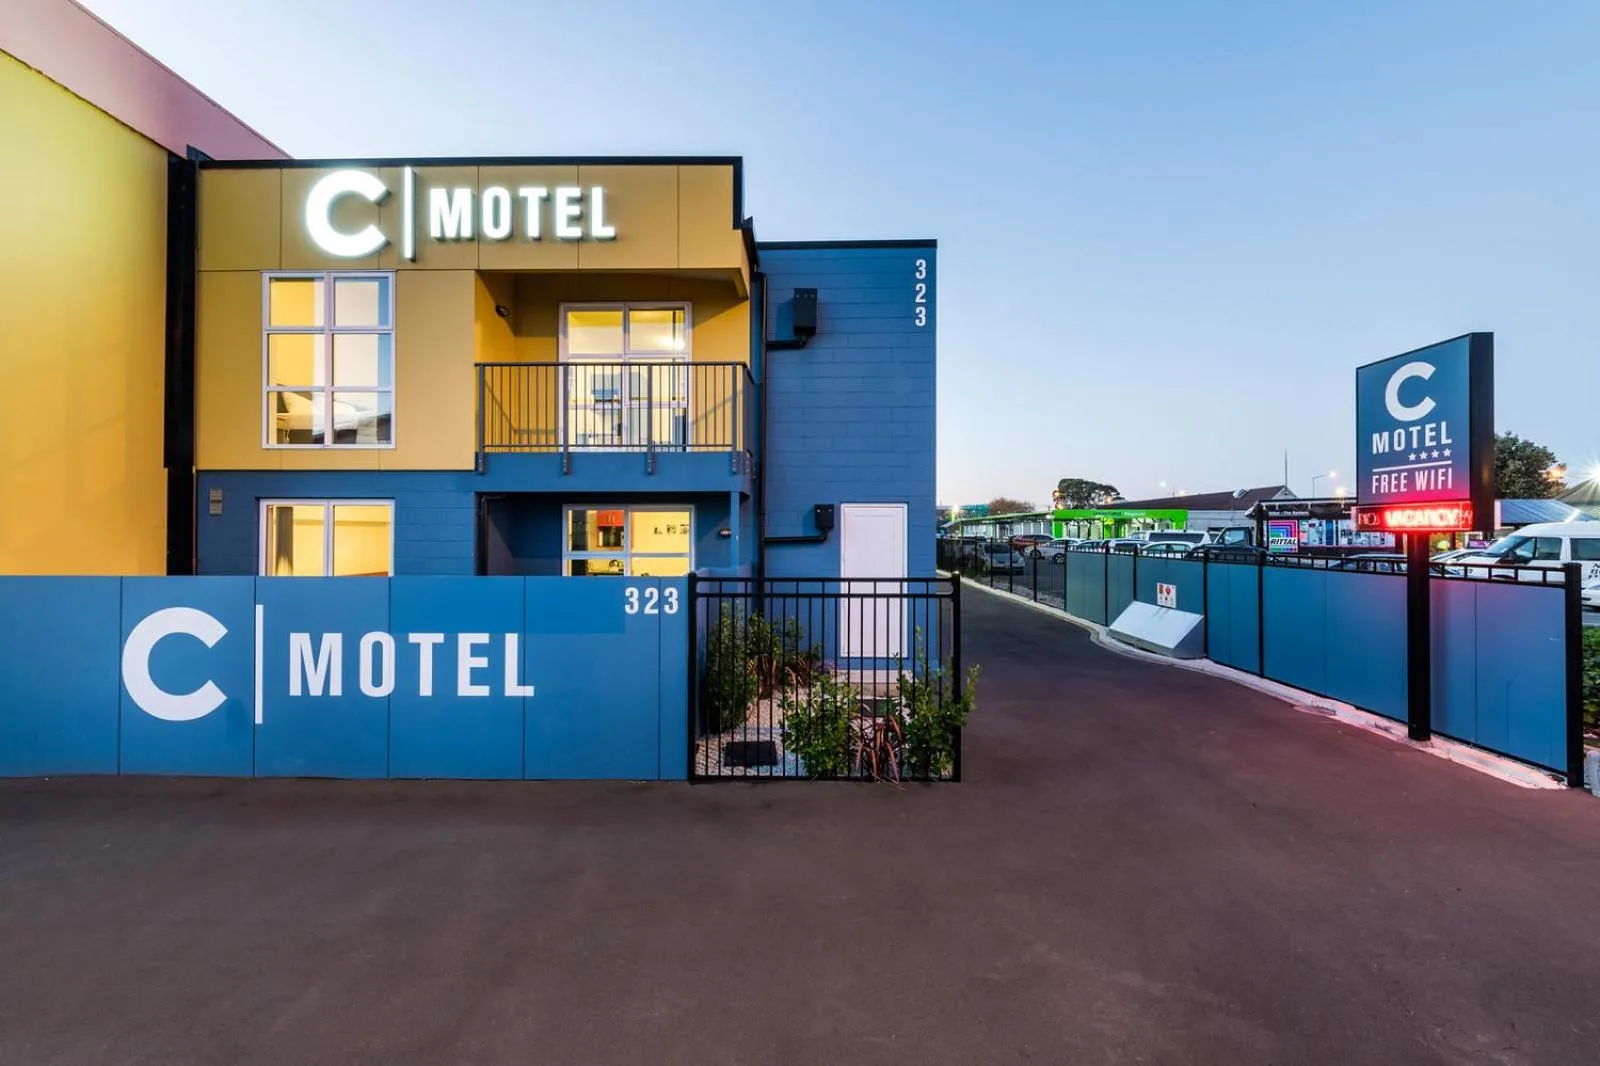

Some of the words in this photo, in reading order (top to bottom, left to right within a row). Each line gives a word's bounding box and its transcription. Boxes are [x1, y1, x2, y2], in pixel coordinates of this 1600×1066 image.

[306, 169, 388, 257] C
[429, 186, 616, 240] MOTEL
[915, 259, 927, 327] 323
[1385, 361, 1437, 421] C
[1372, 421, 1452, 455] MOTEL
[1372, 472, 1408, 494] FREE
[1415, 467, 1452, 492] WIFI
[1384, 508, 1462, 528] VACANCY
[1270, 538, 1297, 546] RITTAL
[624, 587, 679, 615] 323
[121, 607, 228, 721] C
[289, 631, 535, 698] MOTEL
